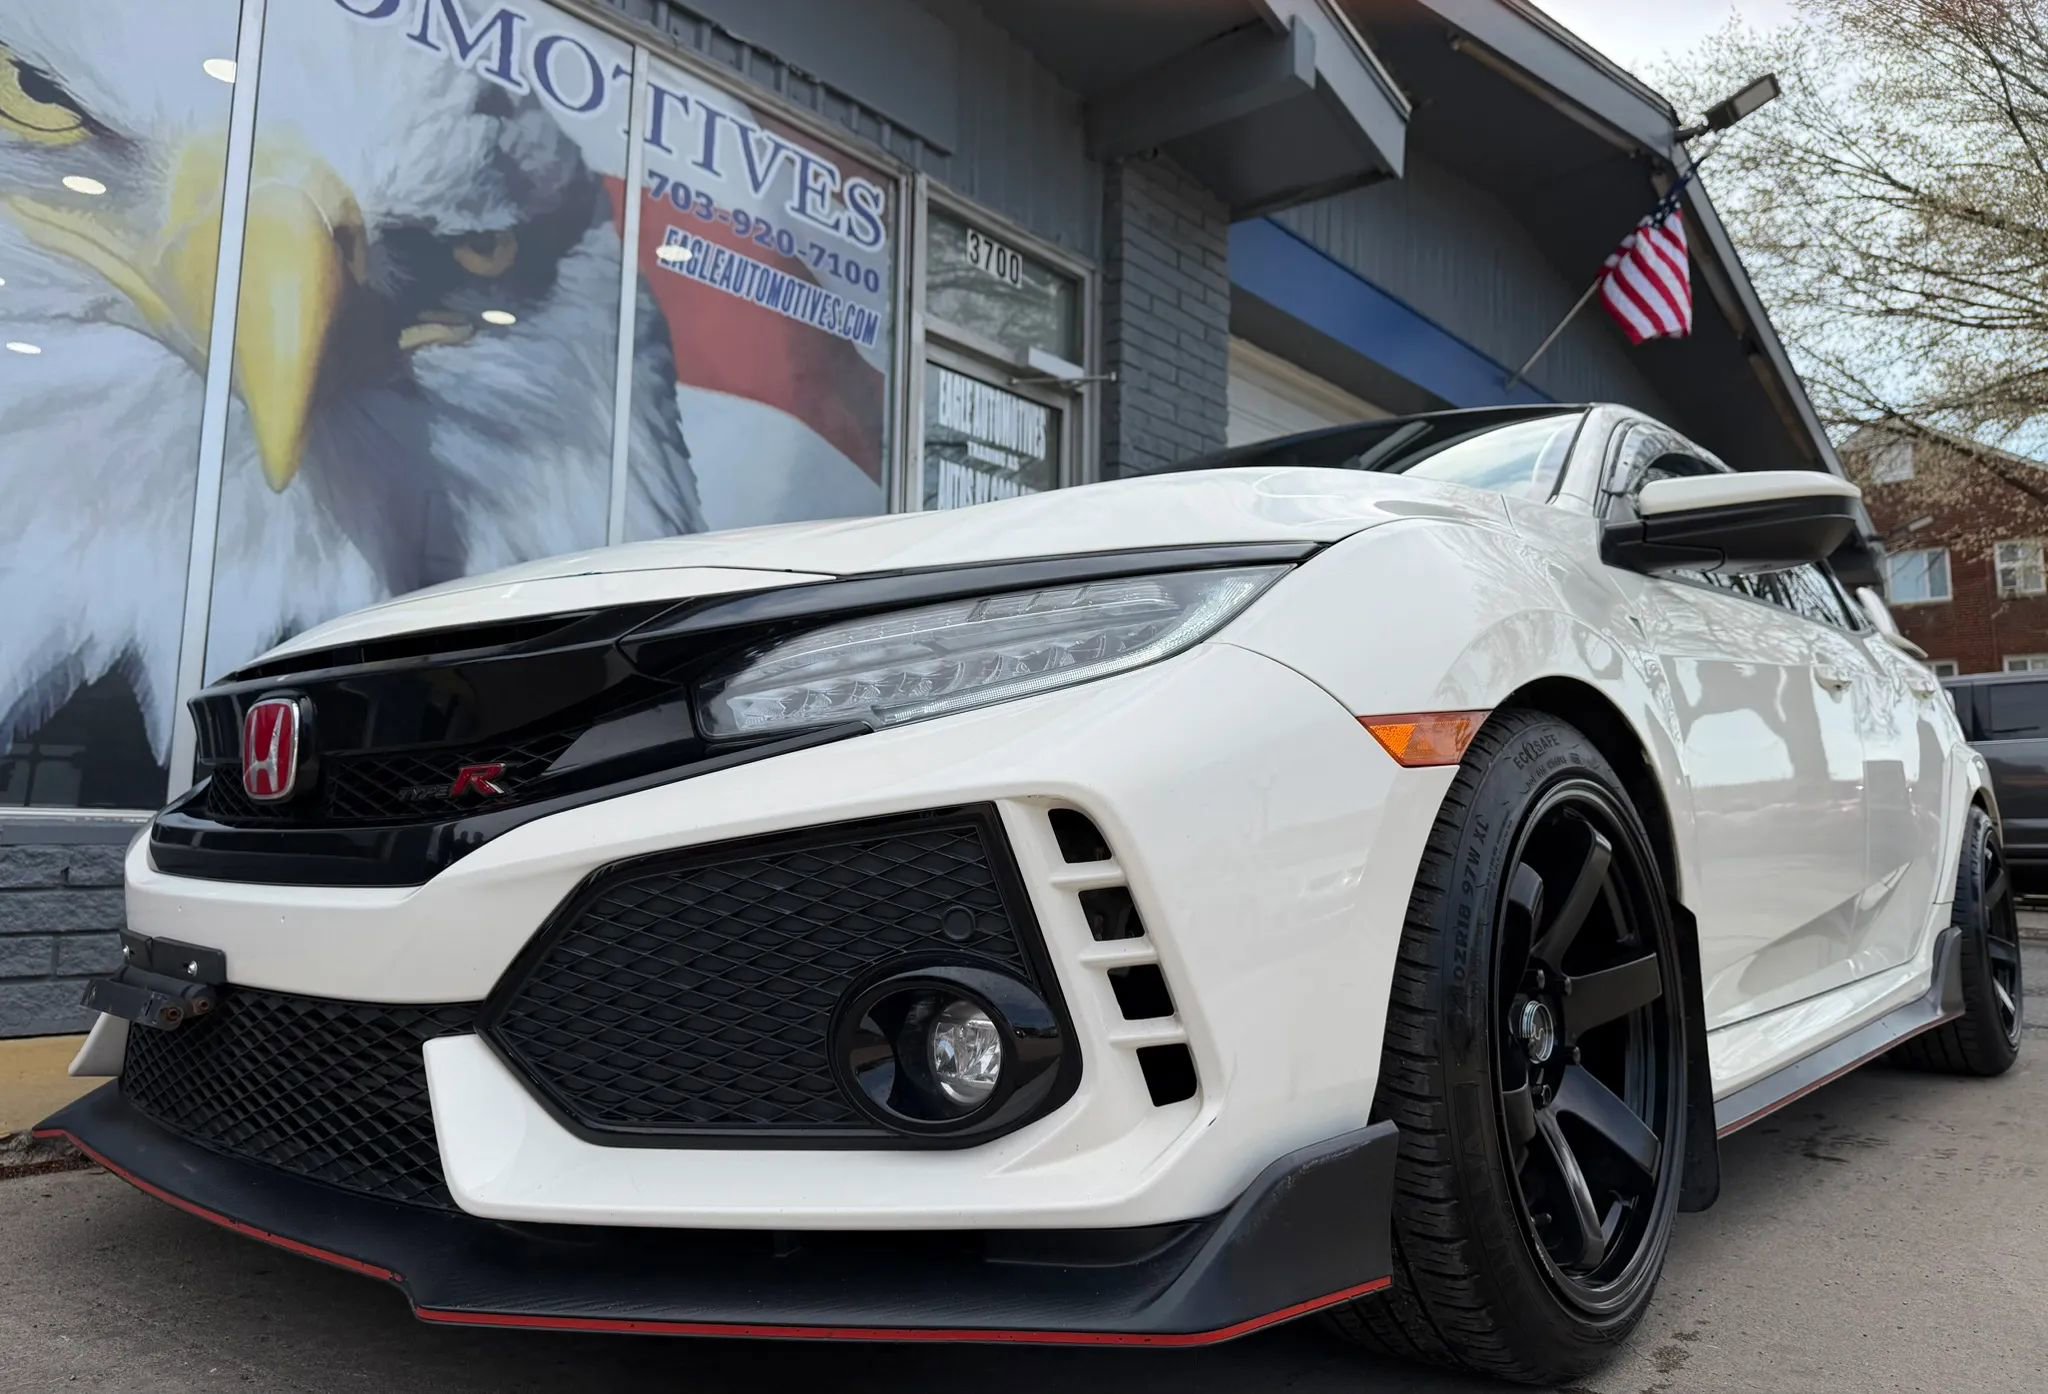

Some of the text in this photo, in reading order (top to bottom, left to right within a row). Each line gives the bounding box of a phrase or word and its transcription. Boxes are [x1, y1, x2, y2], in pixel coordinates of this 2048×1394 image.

[648, 169, 880, 293] 703-920-7100
[969, 233, 1020, 285] 3700
[659, 228, 879, 345] EAGLEAUTOMOTIVES.COM
[449, 762, 506, 799] R
[1461, 846, 1481, 897] 97W
[1451, 903, 1472, 998] 0ZR18
